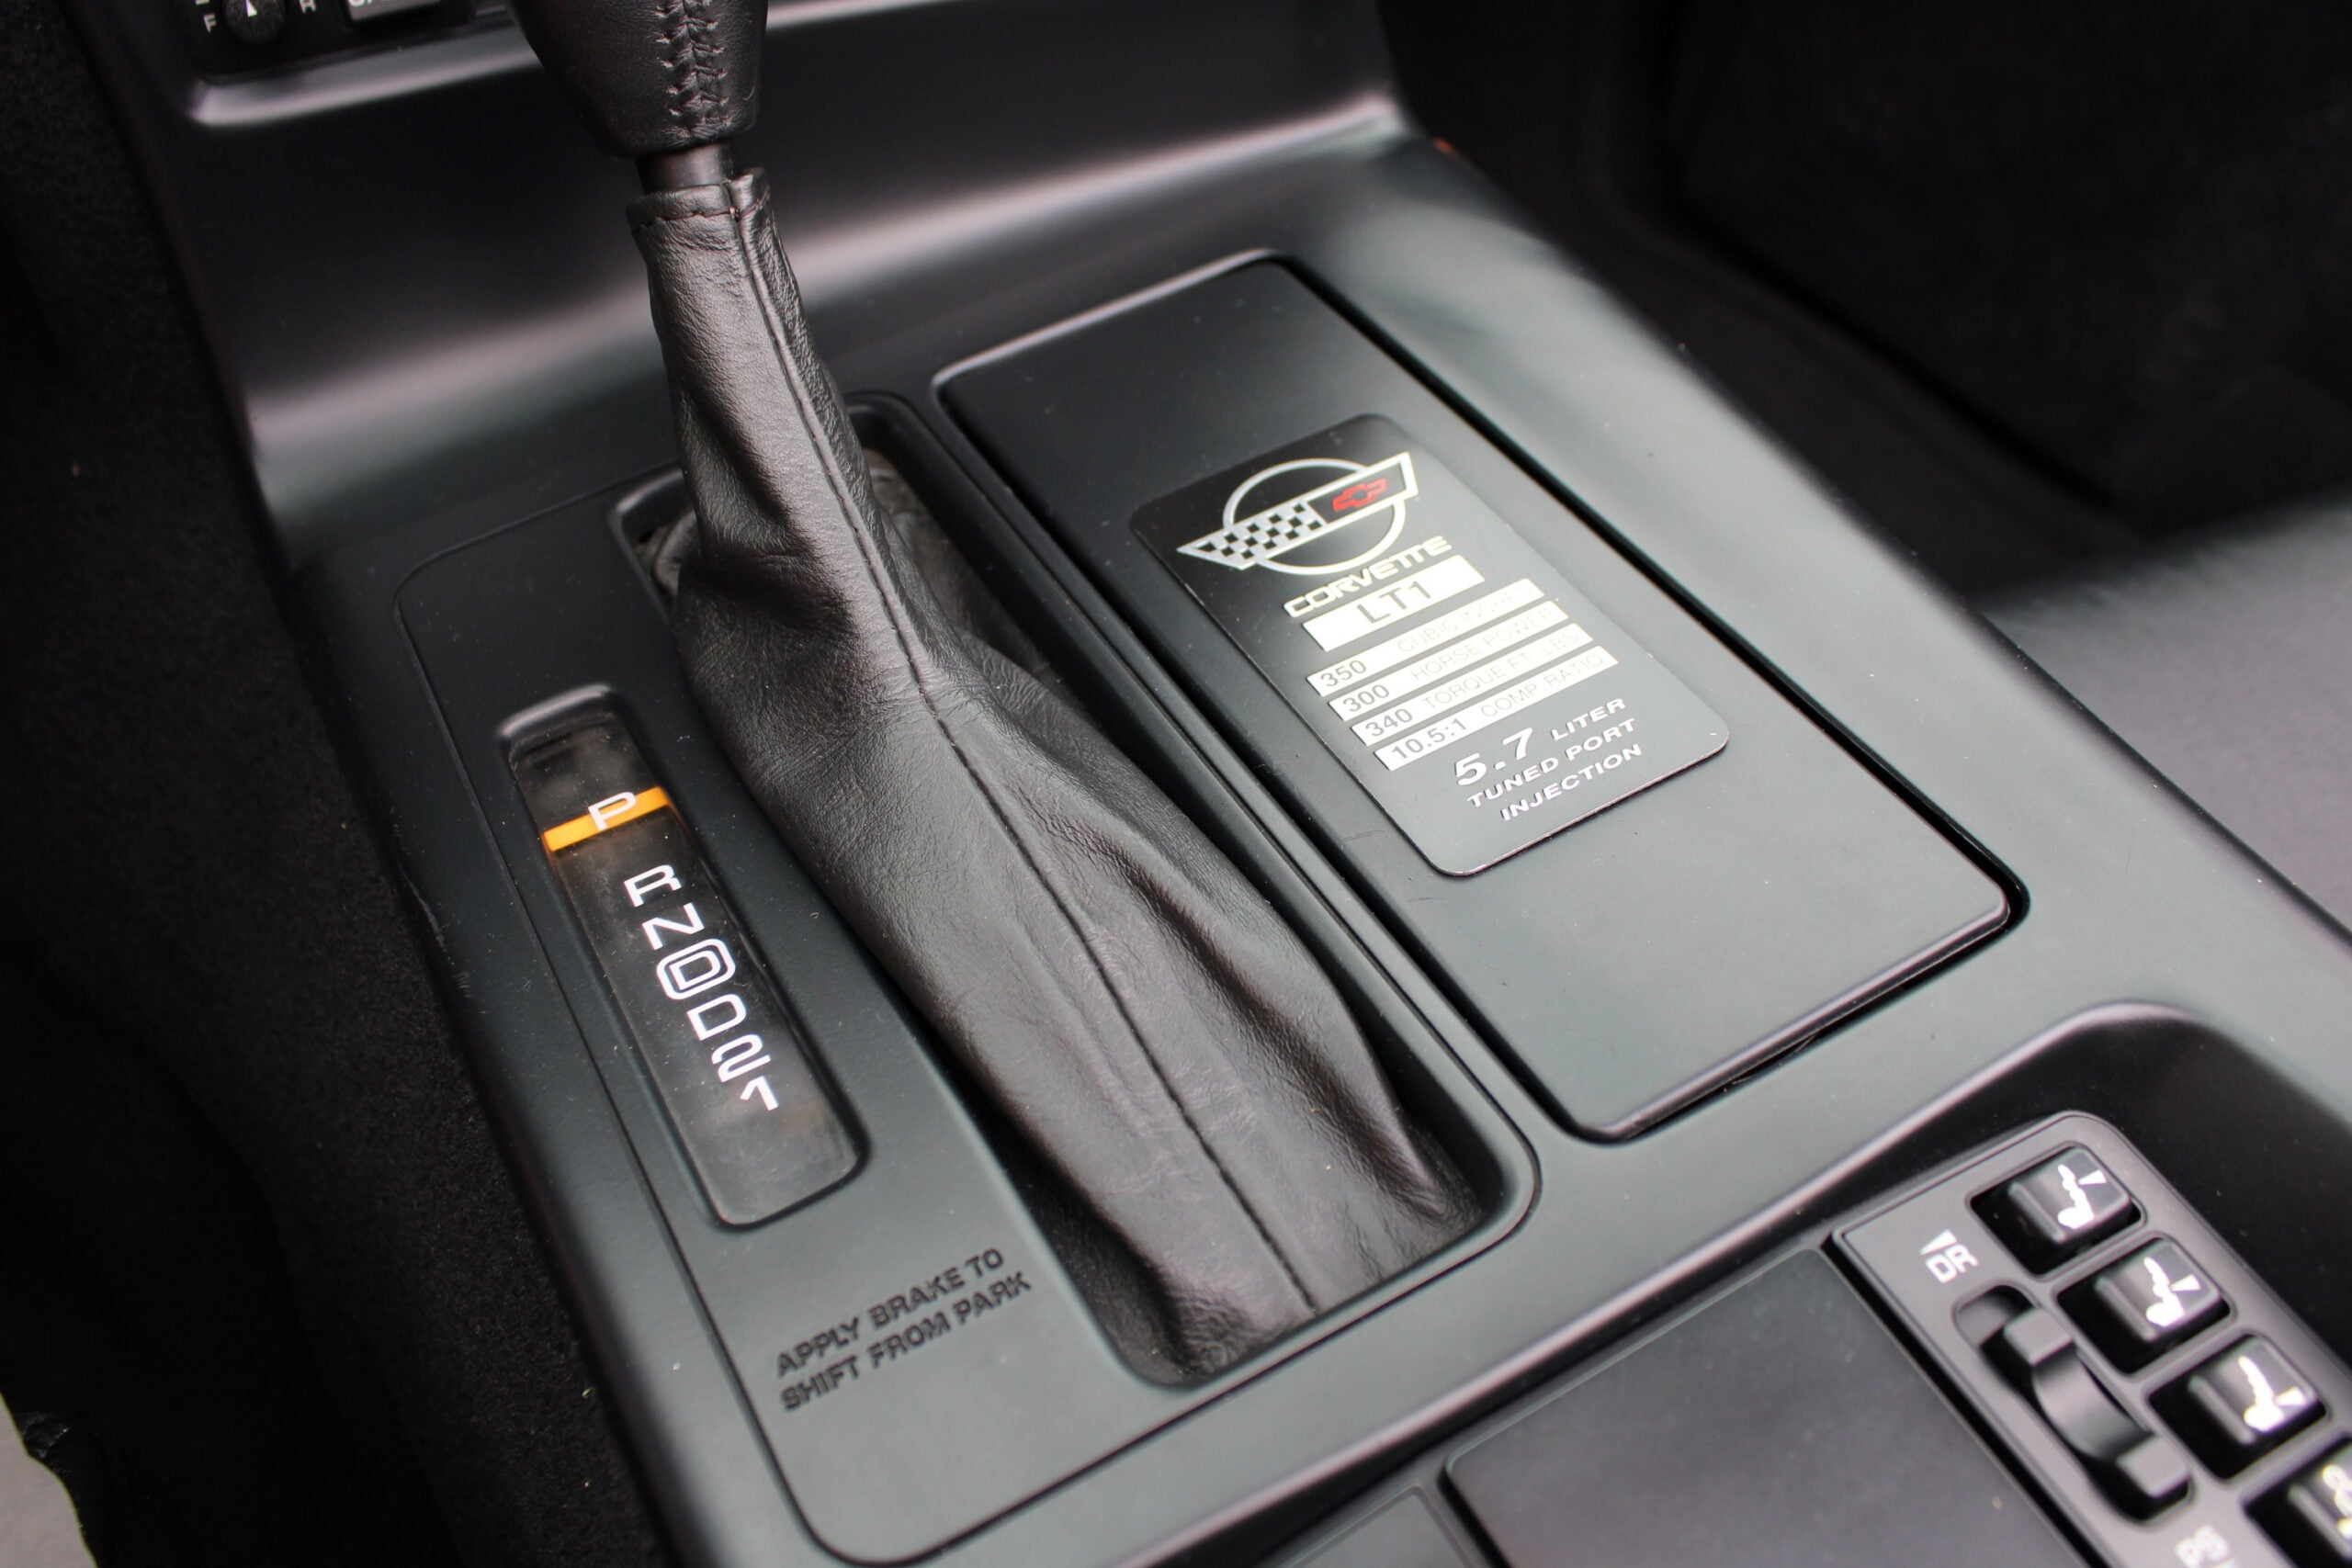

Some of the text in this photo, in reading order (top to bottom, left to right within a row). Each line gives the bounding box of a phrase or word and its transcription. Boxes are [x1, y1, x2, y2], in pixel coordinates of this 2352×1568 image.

[203, 14, 217, 32] F
[1283, 535, 1453, 618] CORVETTE
[1357, 581, 1431, 624] LT1
[1320, 660, 1367, 687] 350
[1397, 618, 1459, 652] CUBIC
[1342, 684, 1390, 712] 300
[1410, 640, 1482, 682] HORSE
[1365, 708, 1413, 737] 340
[1420, 664, 1508, 709] TORQUE
[1391, 653, 1603, 759] 10.5:1 COMP RATIO
[1455, 697, 1627, 786] 5.7 LITER
[1466, 717, 1635, 807] TUNED PORT
[588, 791, 637, 831] P
[1500, 743, 1643, 821] INJECTION
[623, 863, 683, 908] R
[642, 902, 705, 950] N
[686, 993, 747, 1041] D
[711, 1033, 772, 1083] 2
[740, 1076, 779, 1111] 1
[1925, 1243, 1979, 1283] DR
[776, 1247, 1004, 1378] APPLY BRAKE TO
[781, 1271, 1031, 1411] SHIFT FROM PARK
